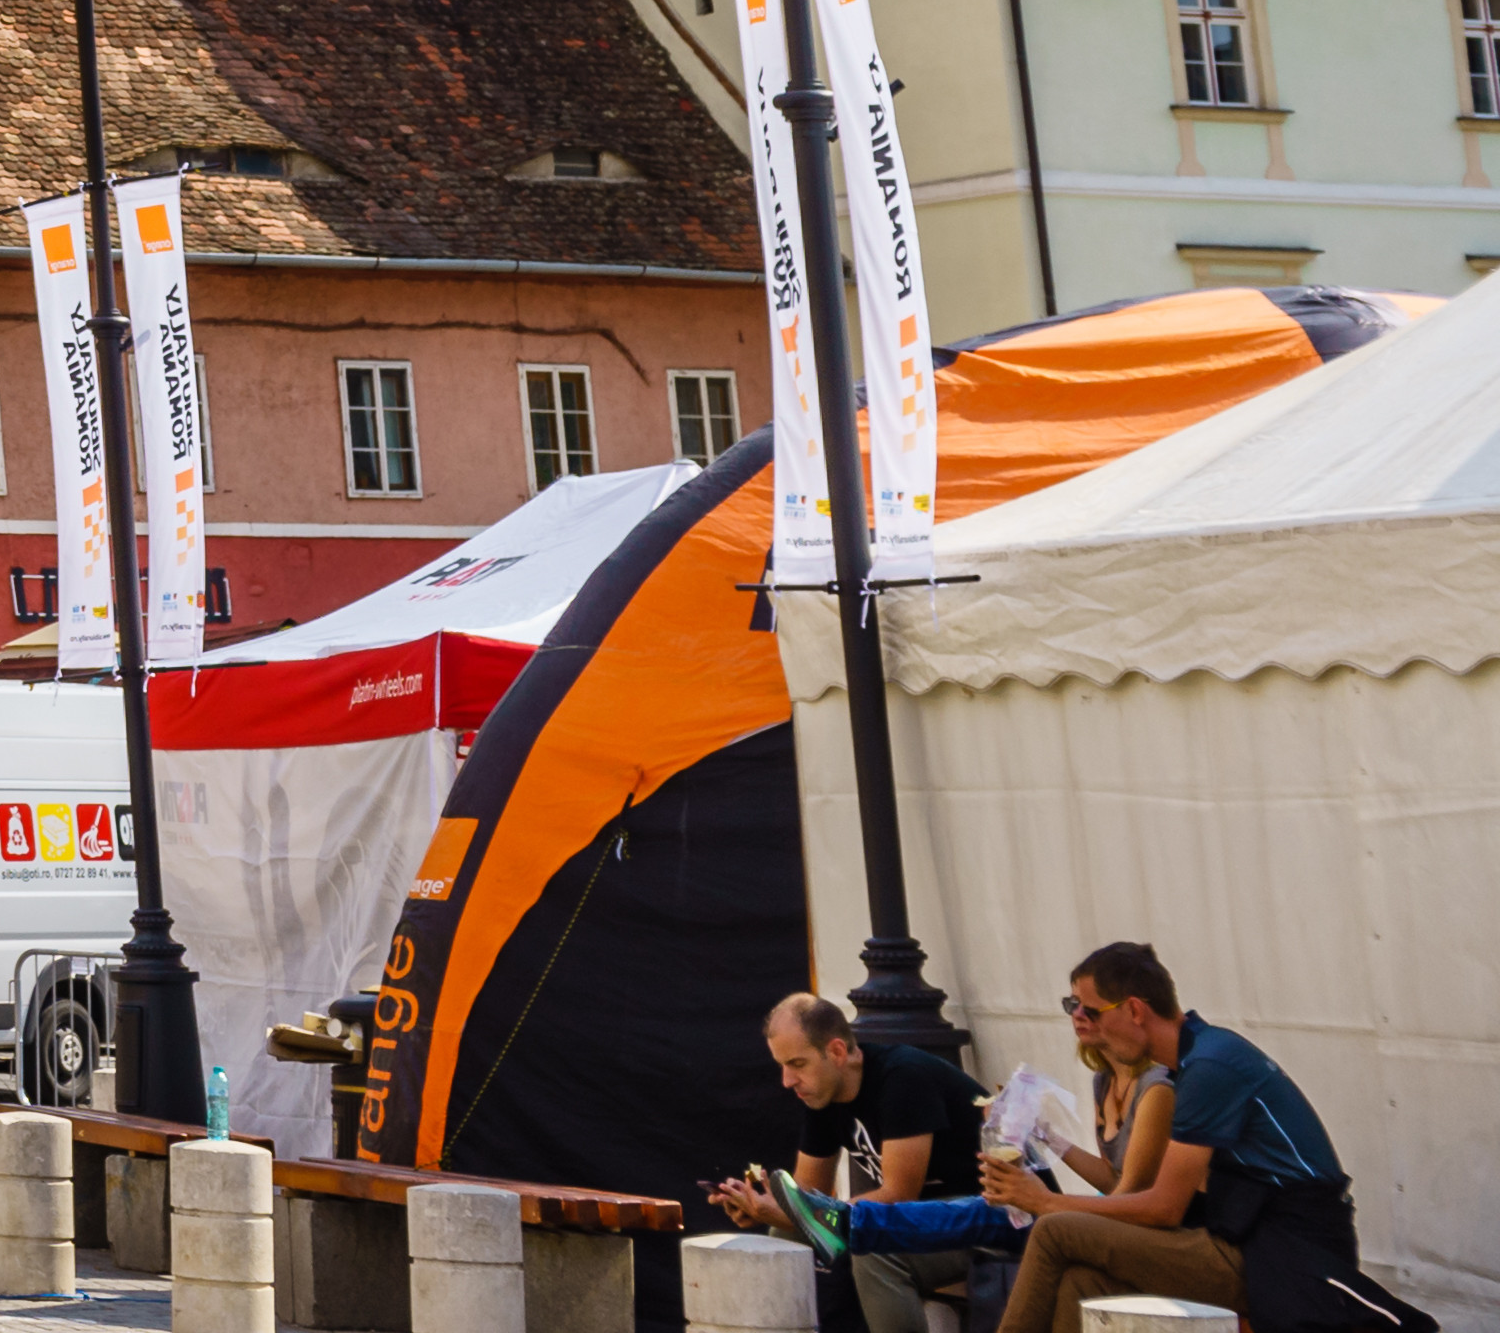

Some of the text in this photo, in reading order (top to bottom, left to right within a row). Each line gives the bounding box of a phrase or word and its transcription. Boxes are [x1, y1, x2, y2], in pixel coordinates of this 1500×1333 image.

[349, 670, 424, 712] platin-wheels.com
[55, 867, 73, 879] 0727
[76, 868, 85, 879] 22
[357, 935, 419, 1164] range
